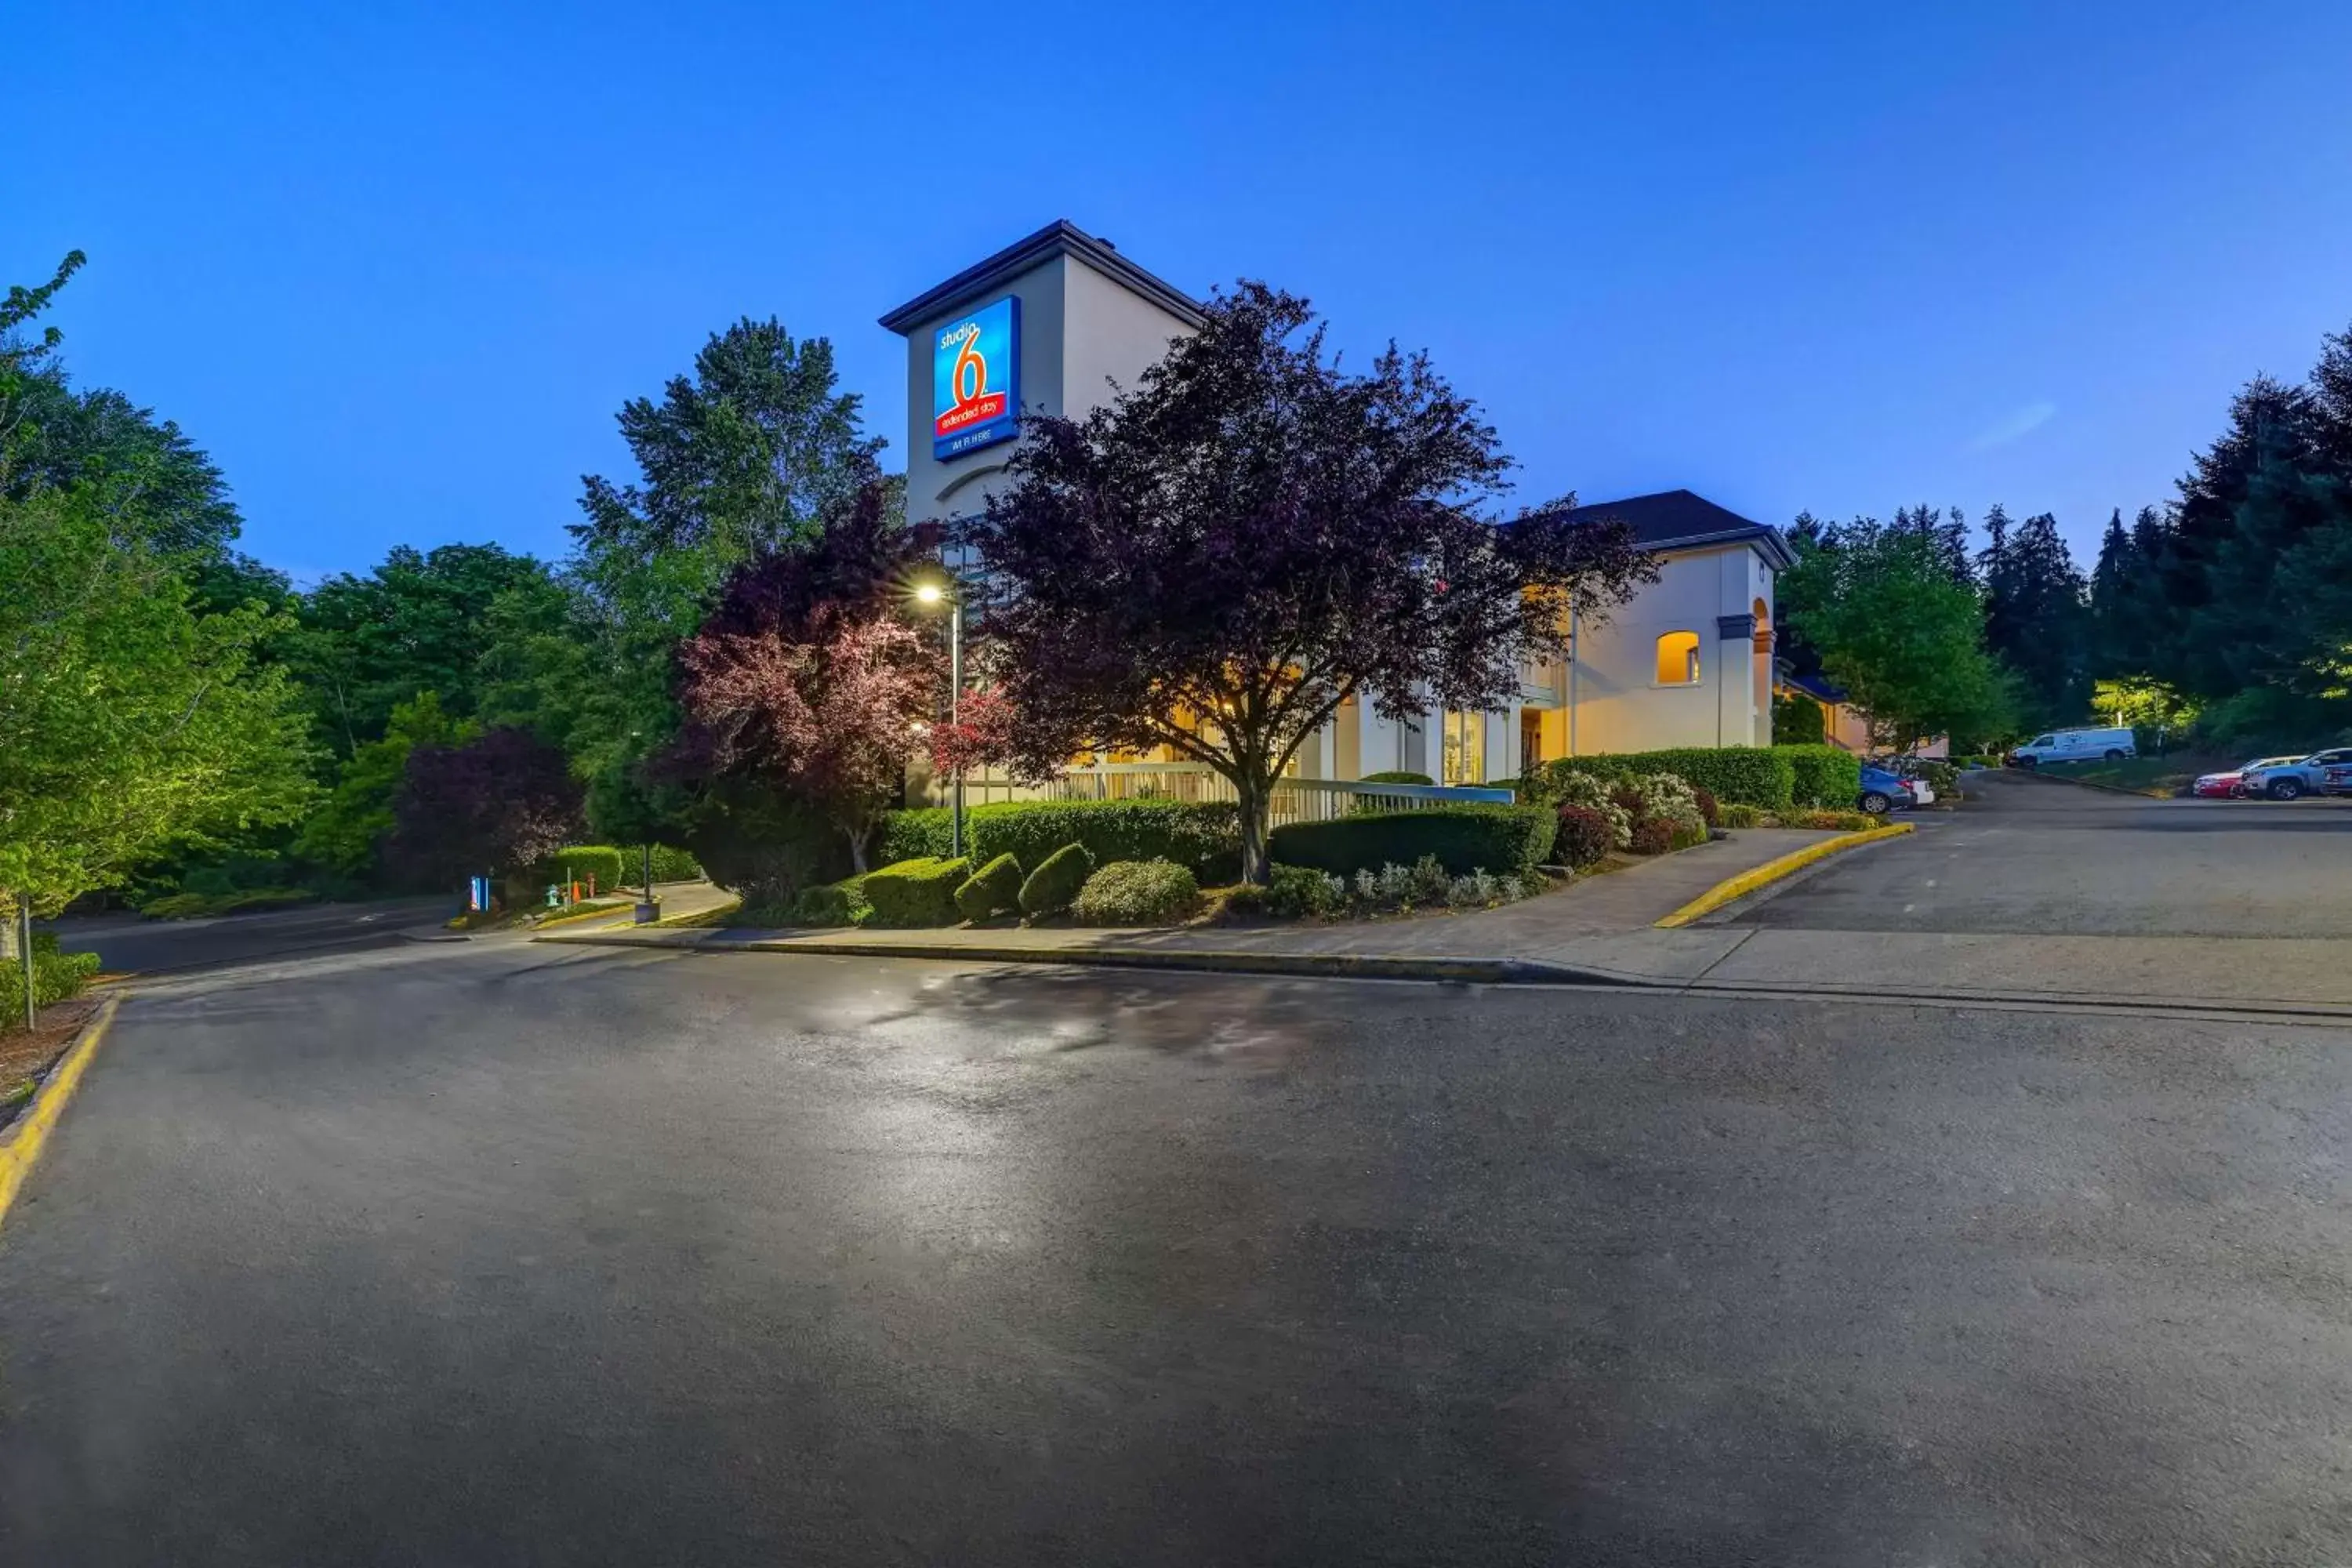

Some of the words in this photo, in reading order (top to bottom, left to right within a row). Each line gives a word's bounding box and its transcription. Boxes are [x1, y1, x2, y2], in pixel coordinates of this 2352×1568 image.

[941, 322, 976, 350] studio
[953, 328, 986, 405] 6
[942, 405, 979, 429] extended
[980, 401, 997, 415] stay
